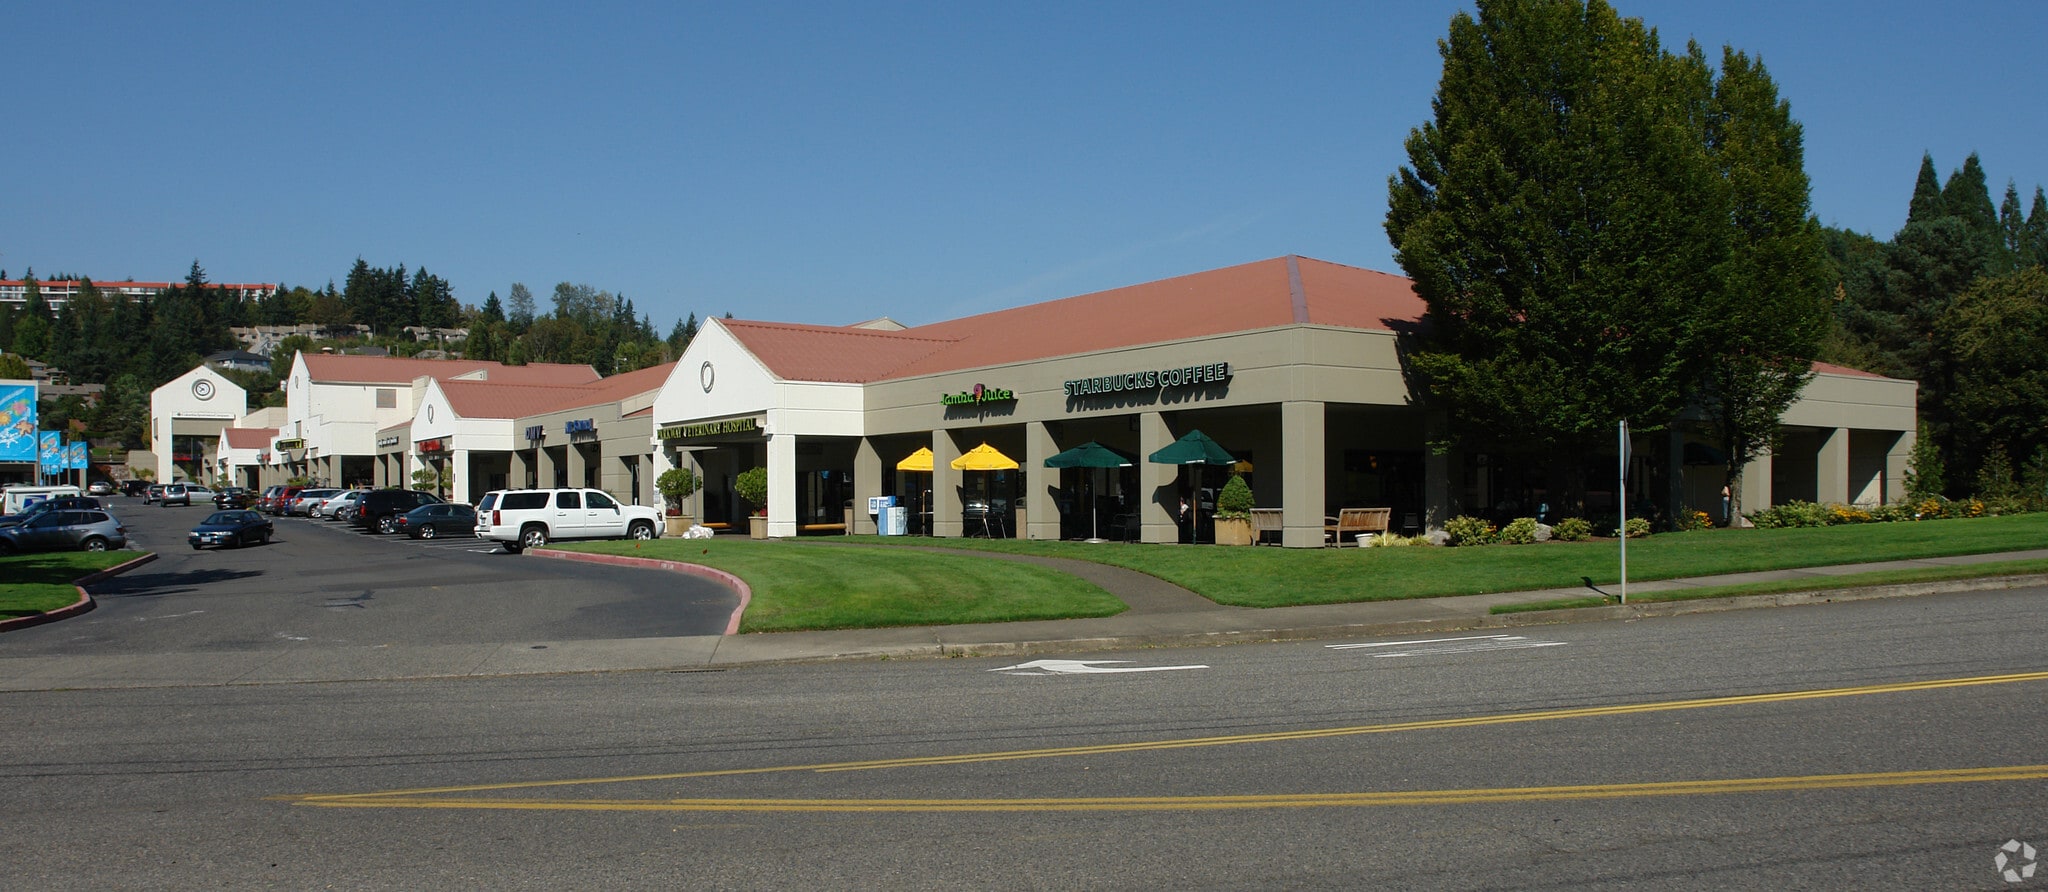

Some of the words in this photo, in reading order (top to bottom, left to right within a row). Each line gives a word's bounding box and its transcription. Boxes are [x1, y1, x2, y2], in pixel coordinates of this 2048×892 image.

[1064, 371, 1158, 396] STARBUCKS
[1159, 362, 1225, 387] COFFEE
[940, 392, 975, 405] Jamba
[981, 388, 1011, 401] Juice
[683, 422, 721, 437] VETERINARY
[722, 418, 755, 433] HOSPITAL
